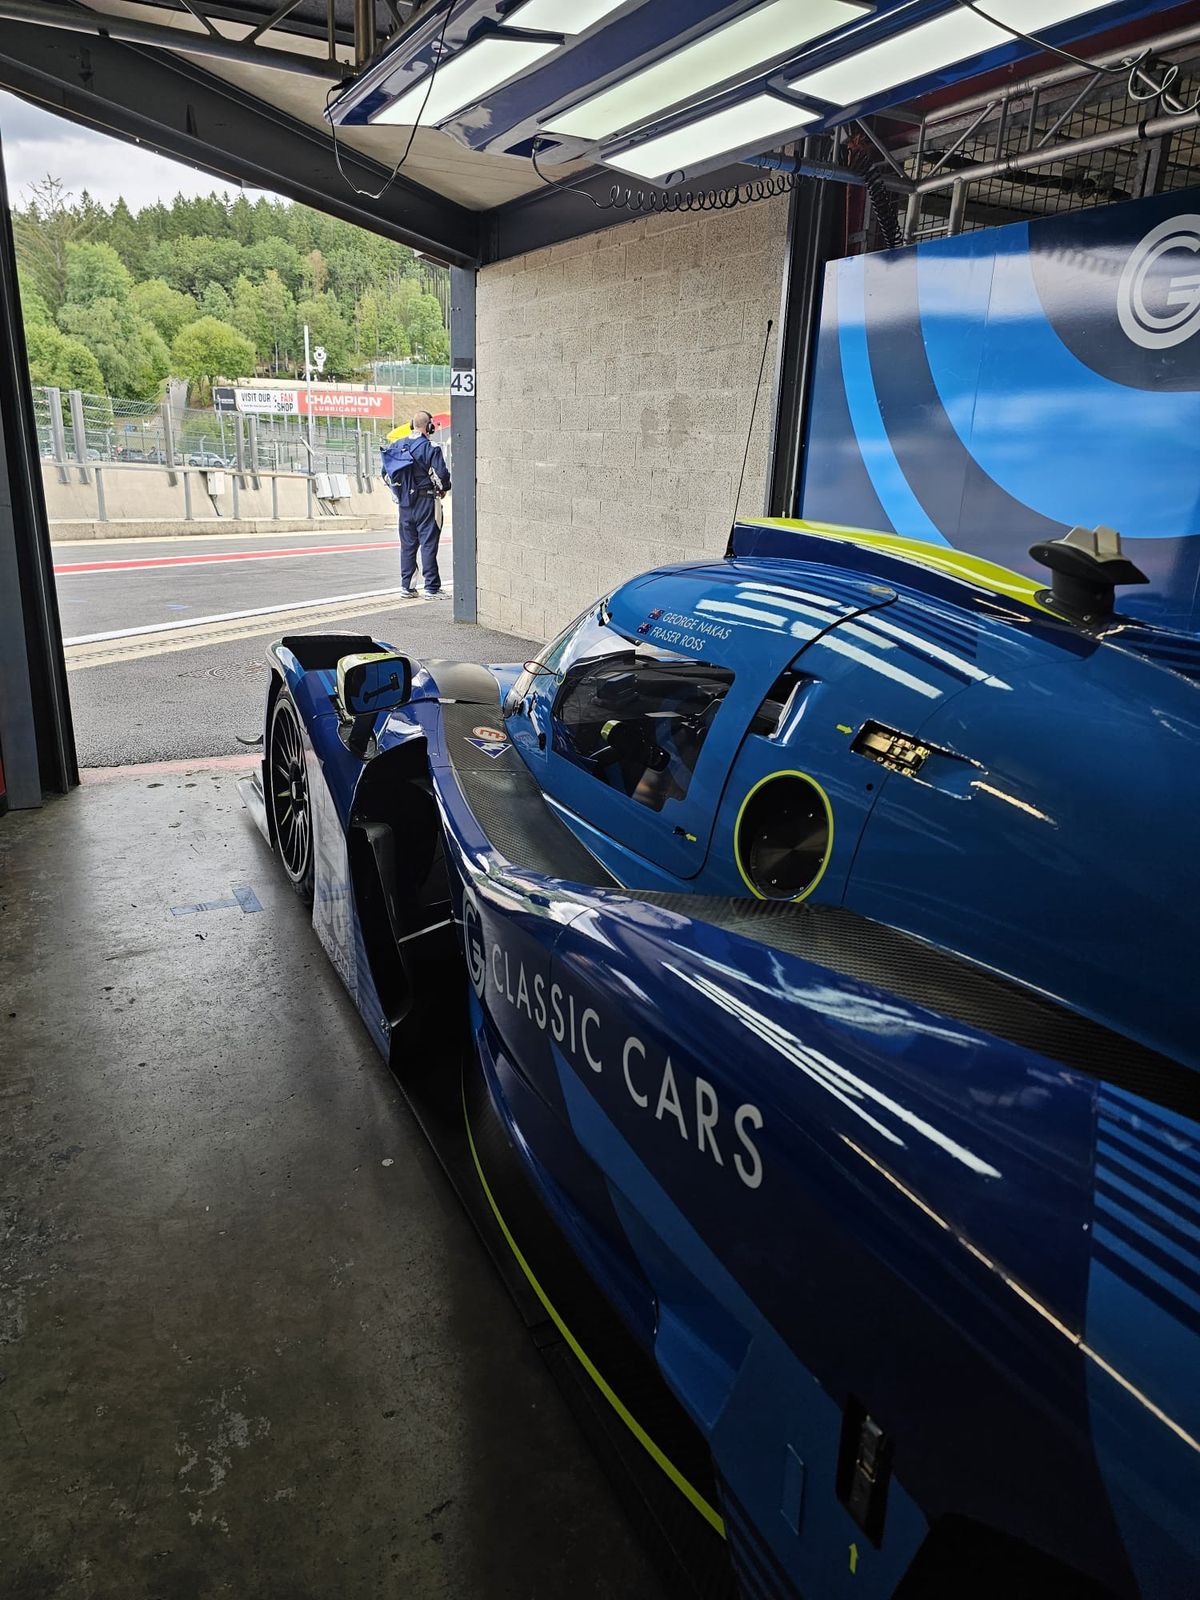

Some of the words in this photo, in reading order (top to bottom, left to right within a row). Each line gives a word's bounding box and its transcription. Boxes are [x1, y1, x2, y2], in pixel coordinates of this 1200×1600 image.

[451, 373, 474, 392] 43
[241, 392, 257, 402] VISIT
[258, 393, 271, 402] OUR
[280, 393, 293, 402] FAN
[305, 394, 382, 407] CHAMPION
[277, 402, 294, 412] SHOP
[662, 612, 697, 629] GEORGE
[696, 621, 732, 640] NAKAS
[651, 626, 681, 644] FRASER
[680, 634, 706, 651] ROSS
[492, 943, 602, 1073] CLASSIC
[622, 1036, 763, 1189] CARS
